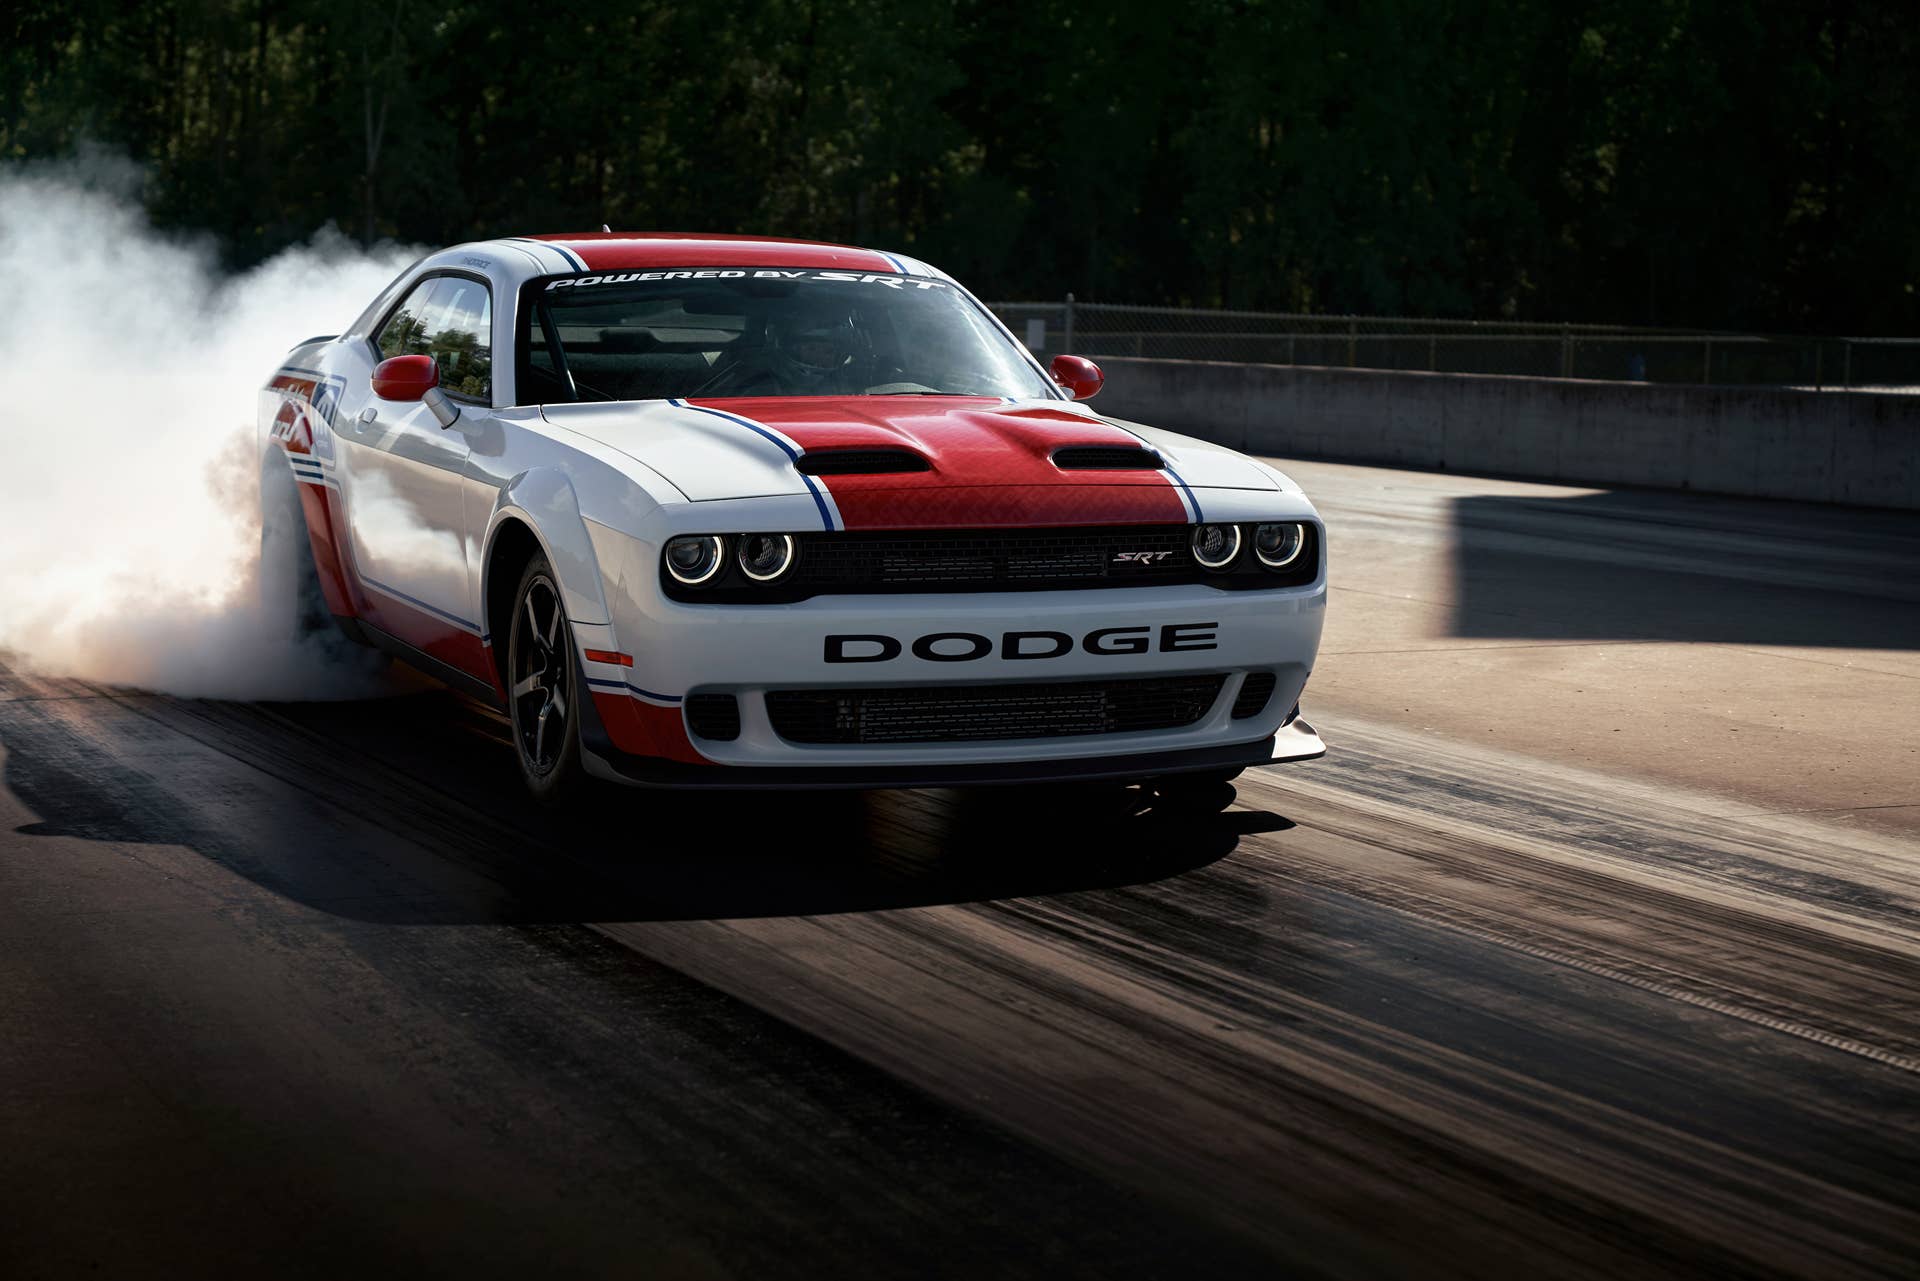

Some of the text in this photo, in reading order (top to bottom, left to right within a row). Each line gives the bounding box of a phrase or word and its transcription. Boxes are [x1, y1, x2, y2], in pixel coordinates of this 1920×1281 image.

[544, 270, 946, 291] POWERED BY SRT
[1112, 551, 1173, 565] SRT
[823, 622, 1219, 664] DODGE
